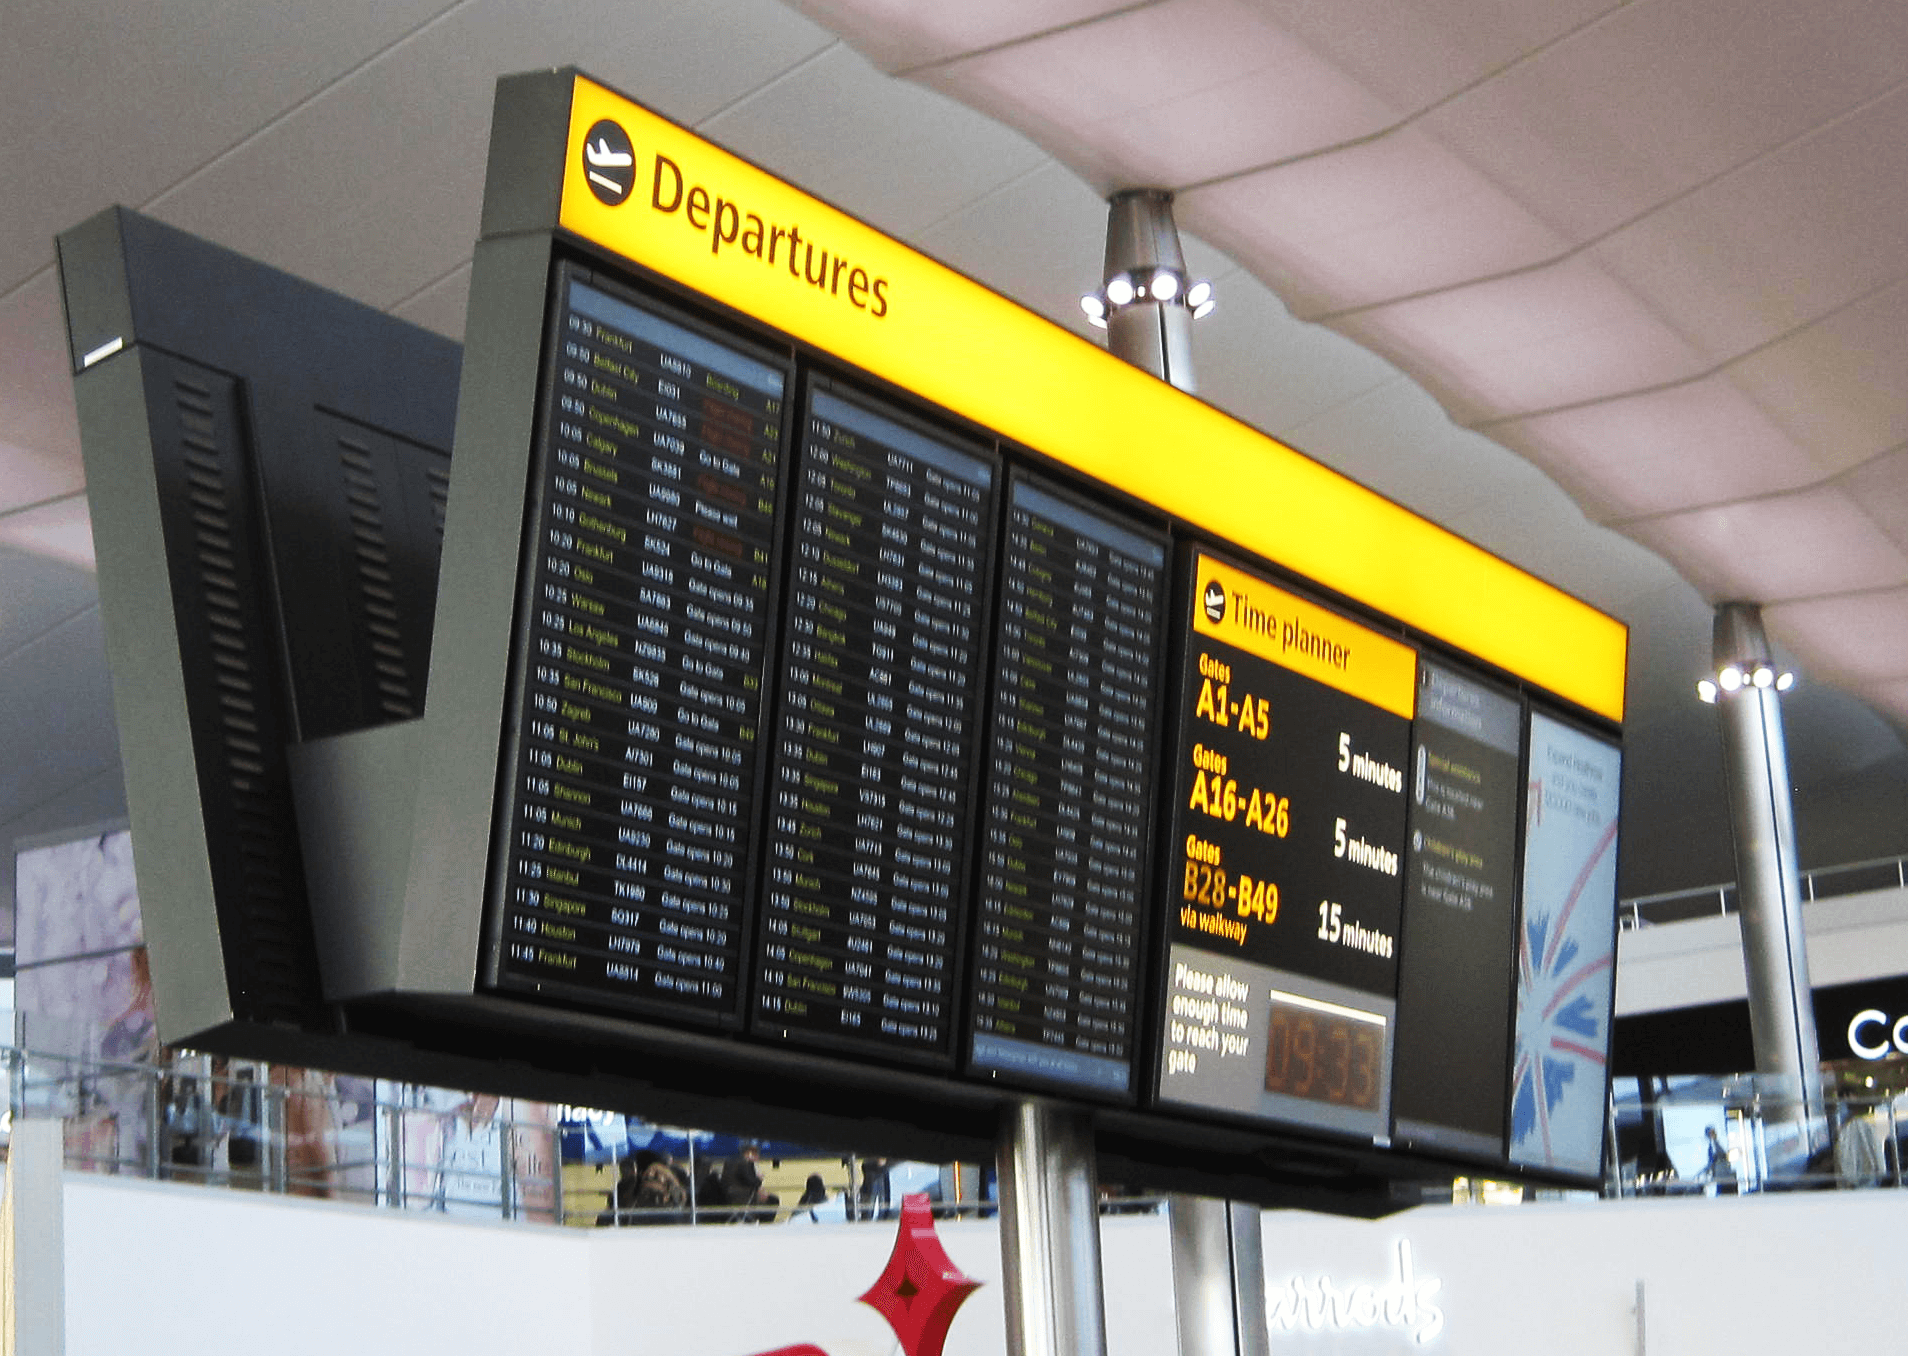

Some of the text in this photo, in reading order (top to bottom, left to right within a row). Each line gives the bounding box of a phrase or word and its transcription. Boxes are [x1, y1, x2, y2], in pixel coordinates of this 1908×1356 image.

[650, 154, 889, 319] Departures
[1232, 590, 1350, 671] Time planner
[1196, 678, 1269, 740] A1-A5
[1338, 732, 1402, 793] 5 minutes
[1190, 770, 1289, 838] A16-A26
[1334, 817, 1398, 876] 5 minutes
[1184, 861, 1278, 924] B28-B49
[1181, 904, 1247, 946] via walkway
[1318, 900, 1392, 958] 15 minutes
[1173, 995, 1248, 1029] enough time
[1175, 962, 1250, 1003] Please allow
[1171, 1019, 1249, 1058] to reach your
